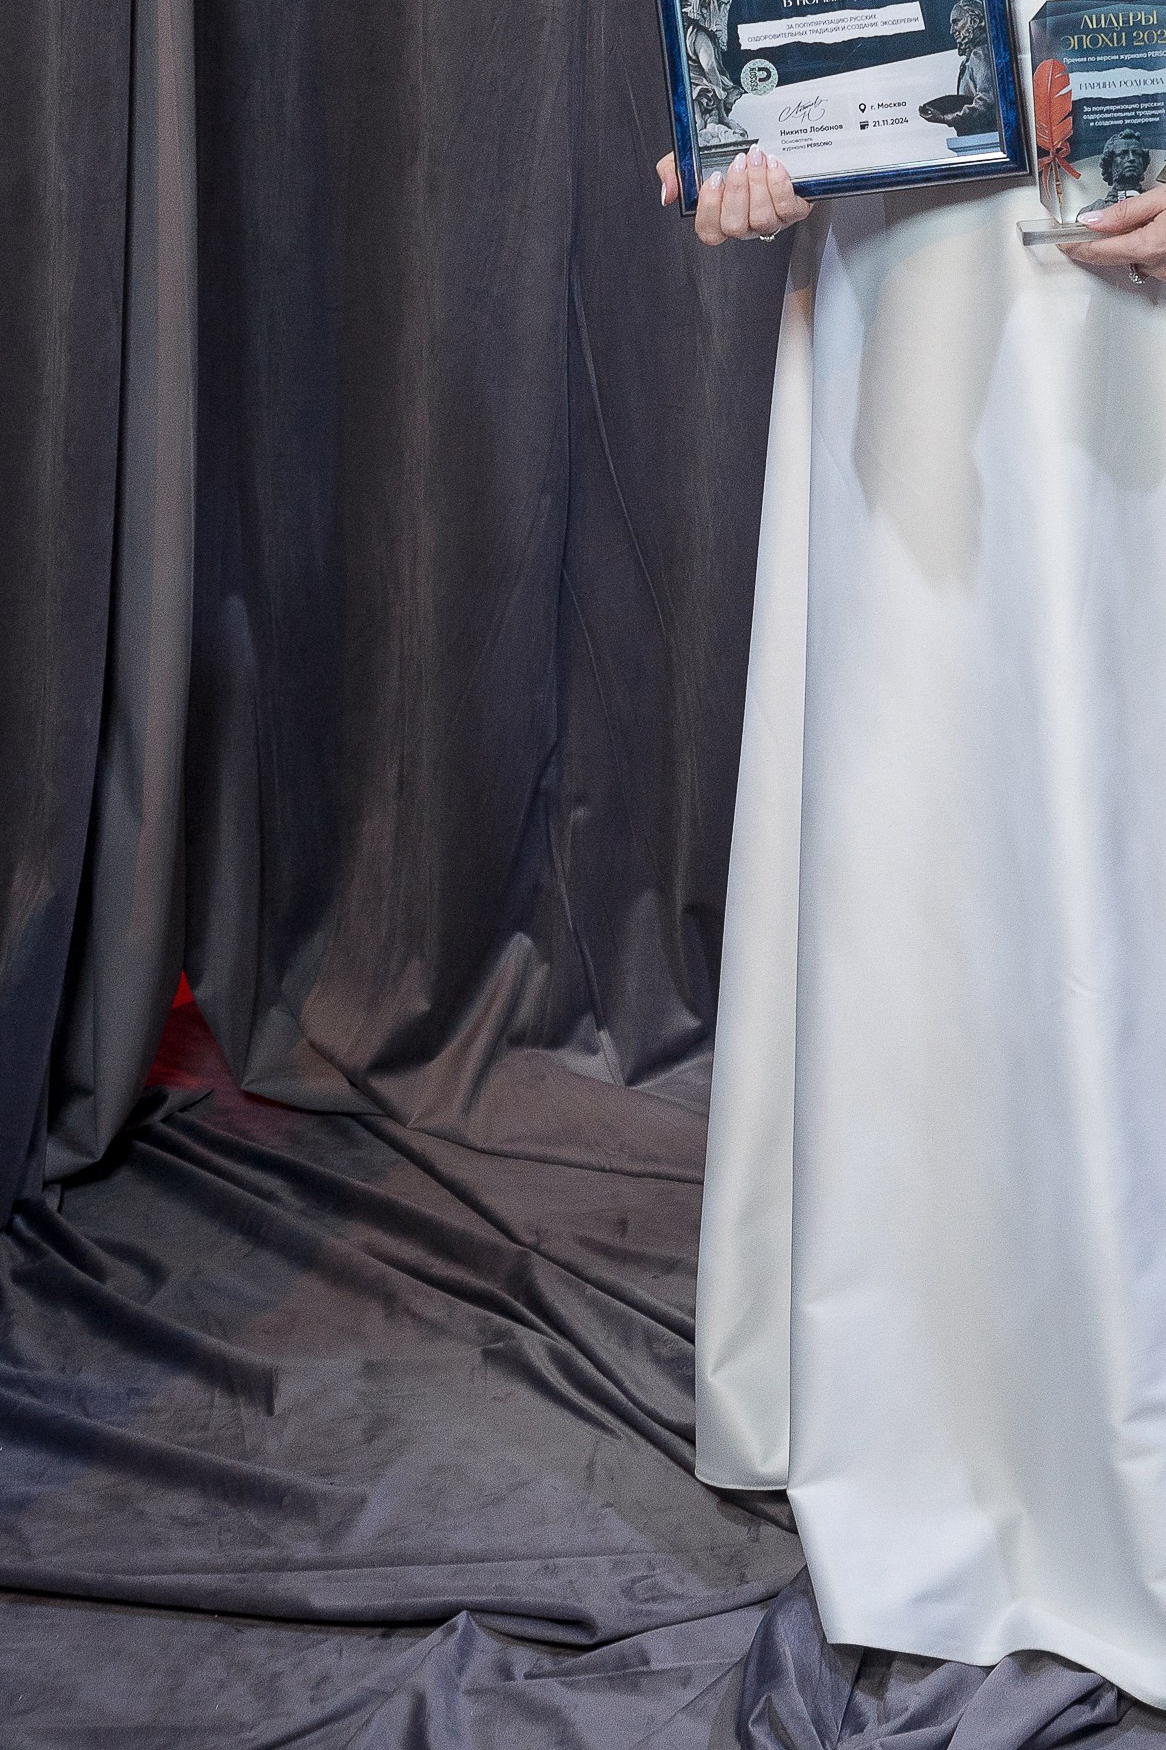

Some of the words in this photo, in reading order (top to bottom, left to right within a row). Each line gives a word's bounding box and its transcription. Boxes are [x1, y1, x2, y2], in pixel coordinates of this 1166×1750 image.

[795, 17, 848, 29] ПОПУЛЯРИЗАЦИЮ
[850, 14, 877, 23] РУССКИХ
[1080, 10, 1158, 31] ЛИДЕРЫ
[747, 30, 808, 42] ОЗДОРОВИТЕЛЬНЫХ
[809, 25, 840, 35] ТРАДИЦИЙ
[847, 21, 878, 31] СОЗДАНИЕ
[880, 17, 919, 27] ЭКОДЕРЕВНИ
[1060, 31, 1126, 51] ЭПОХИ
[1097, 54, 1119, 62] версии
[877, 101, 907, 110] Москва
[872, 117, 909, 128] 21.11.2024
[780, 128, 808, 136] Никита
[809, 124, 843, 133] Лобанов
